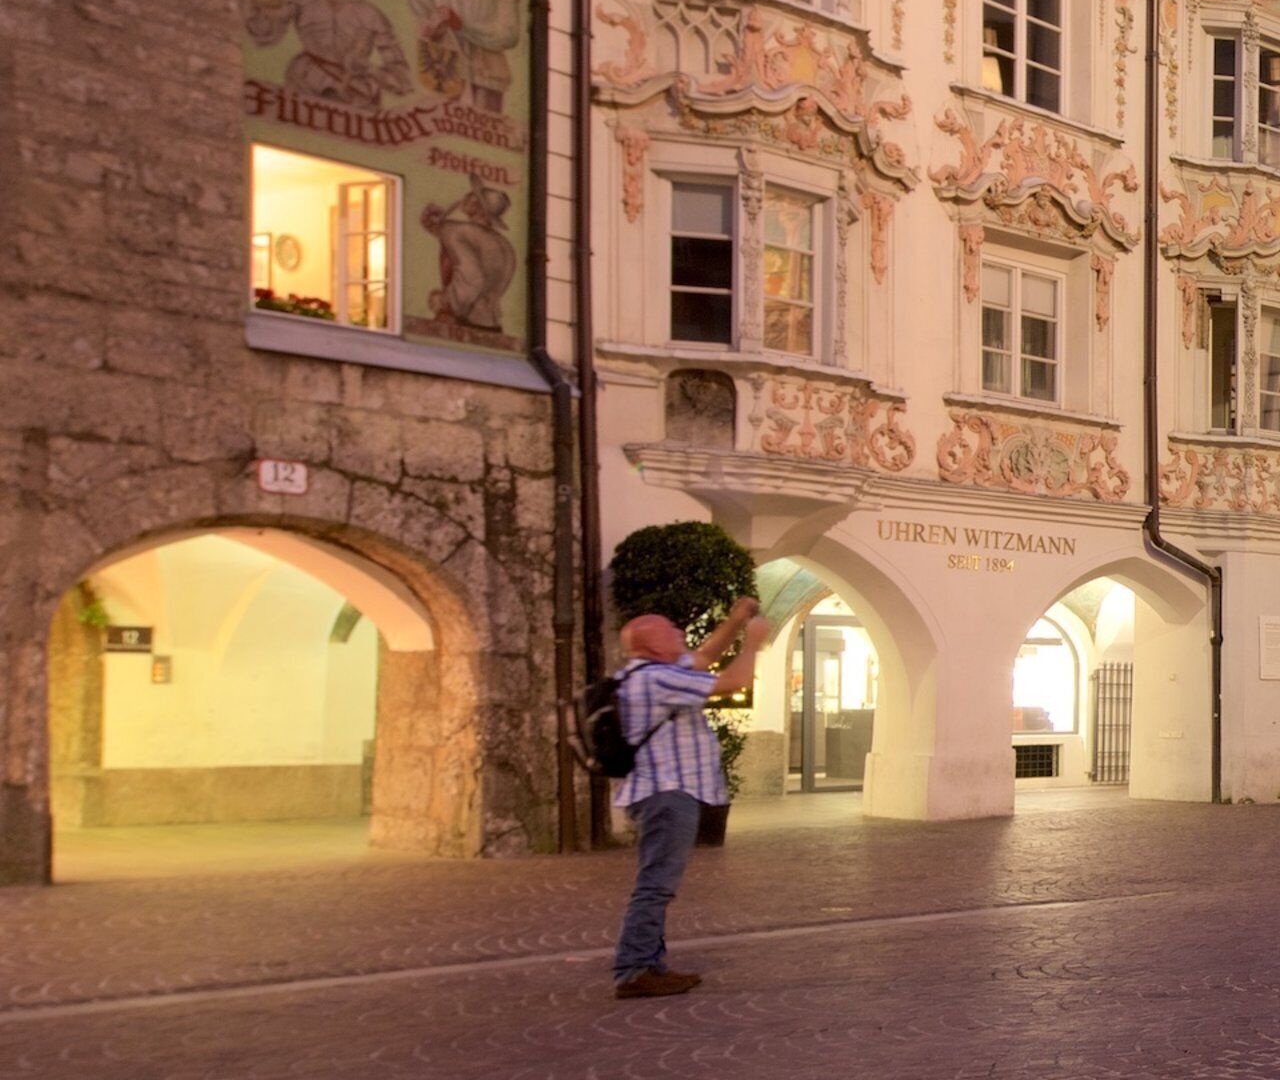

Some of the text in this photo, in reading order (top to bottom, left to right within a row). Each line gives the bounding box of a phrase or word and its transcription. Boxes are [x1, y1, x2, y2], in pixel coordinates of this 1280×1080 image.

[270, 463, 297, 483] 12
[876, 520, 1078, 556] UHREN WITZMANN
[947, 554, 1016, 572] SEIT 1894
